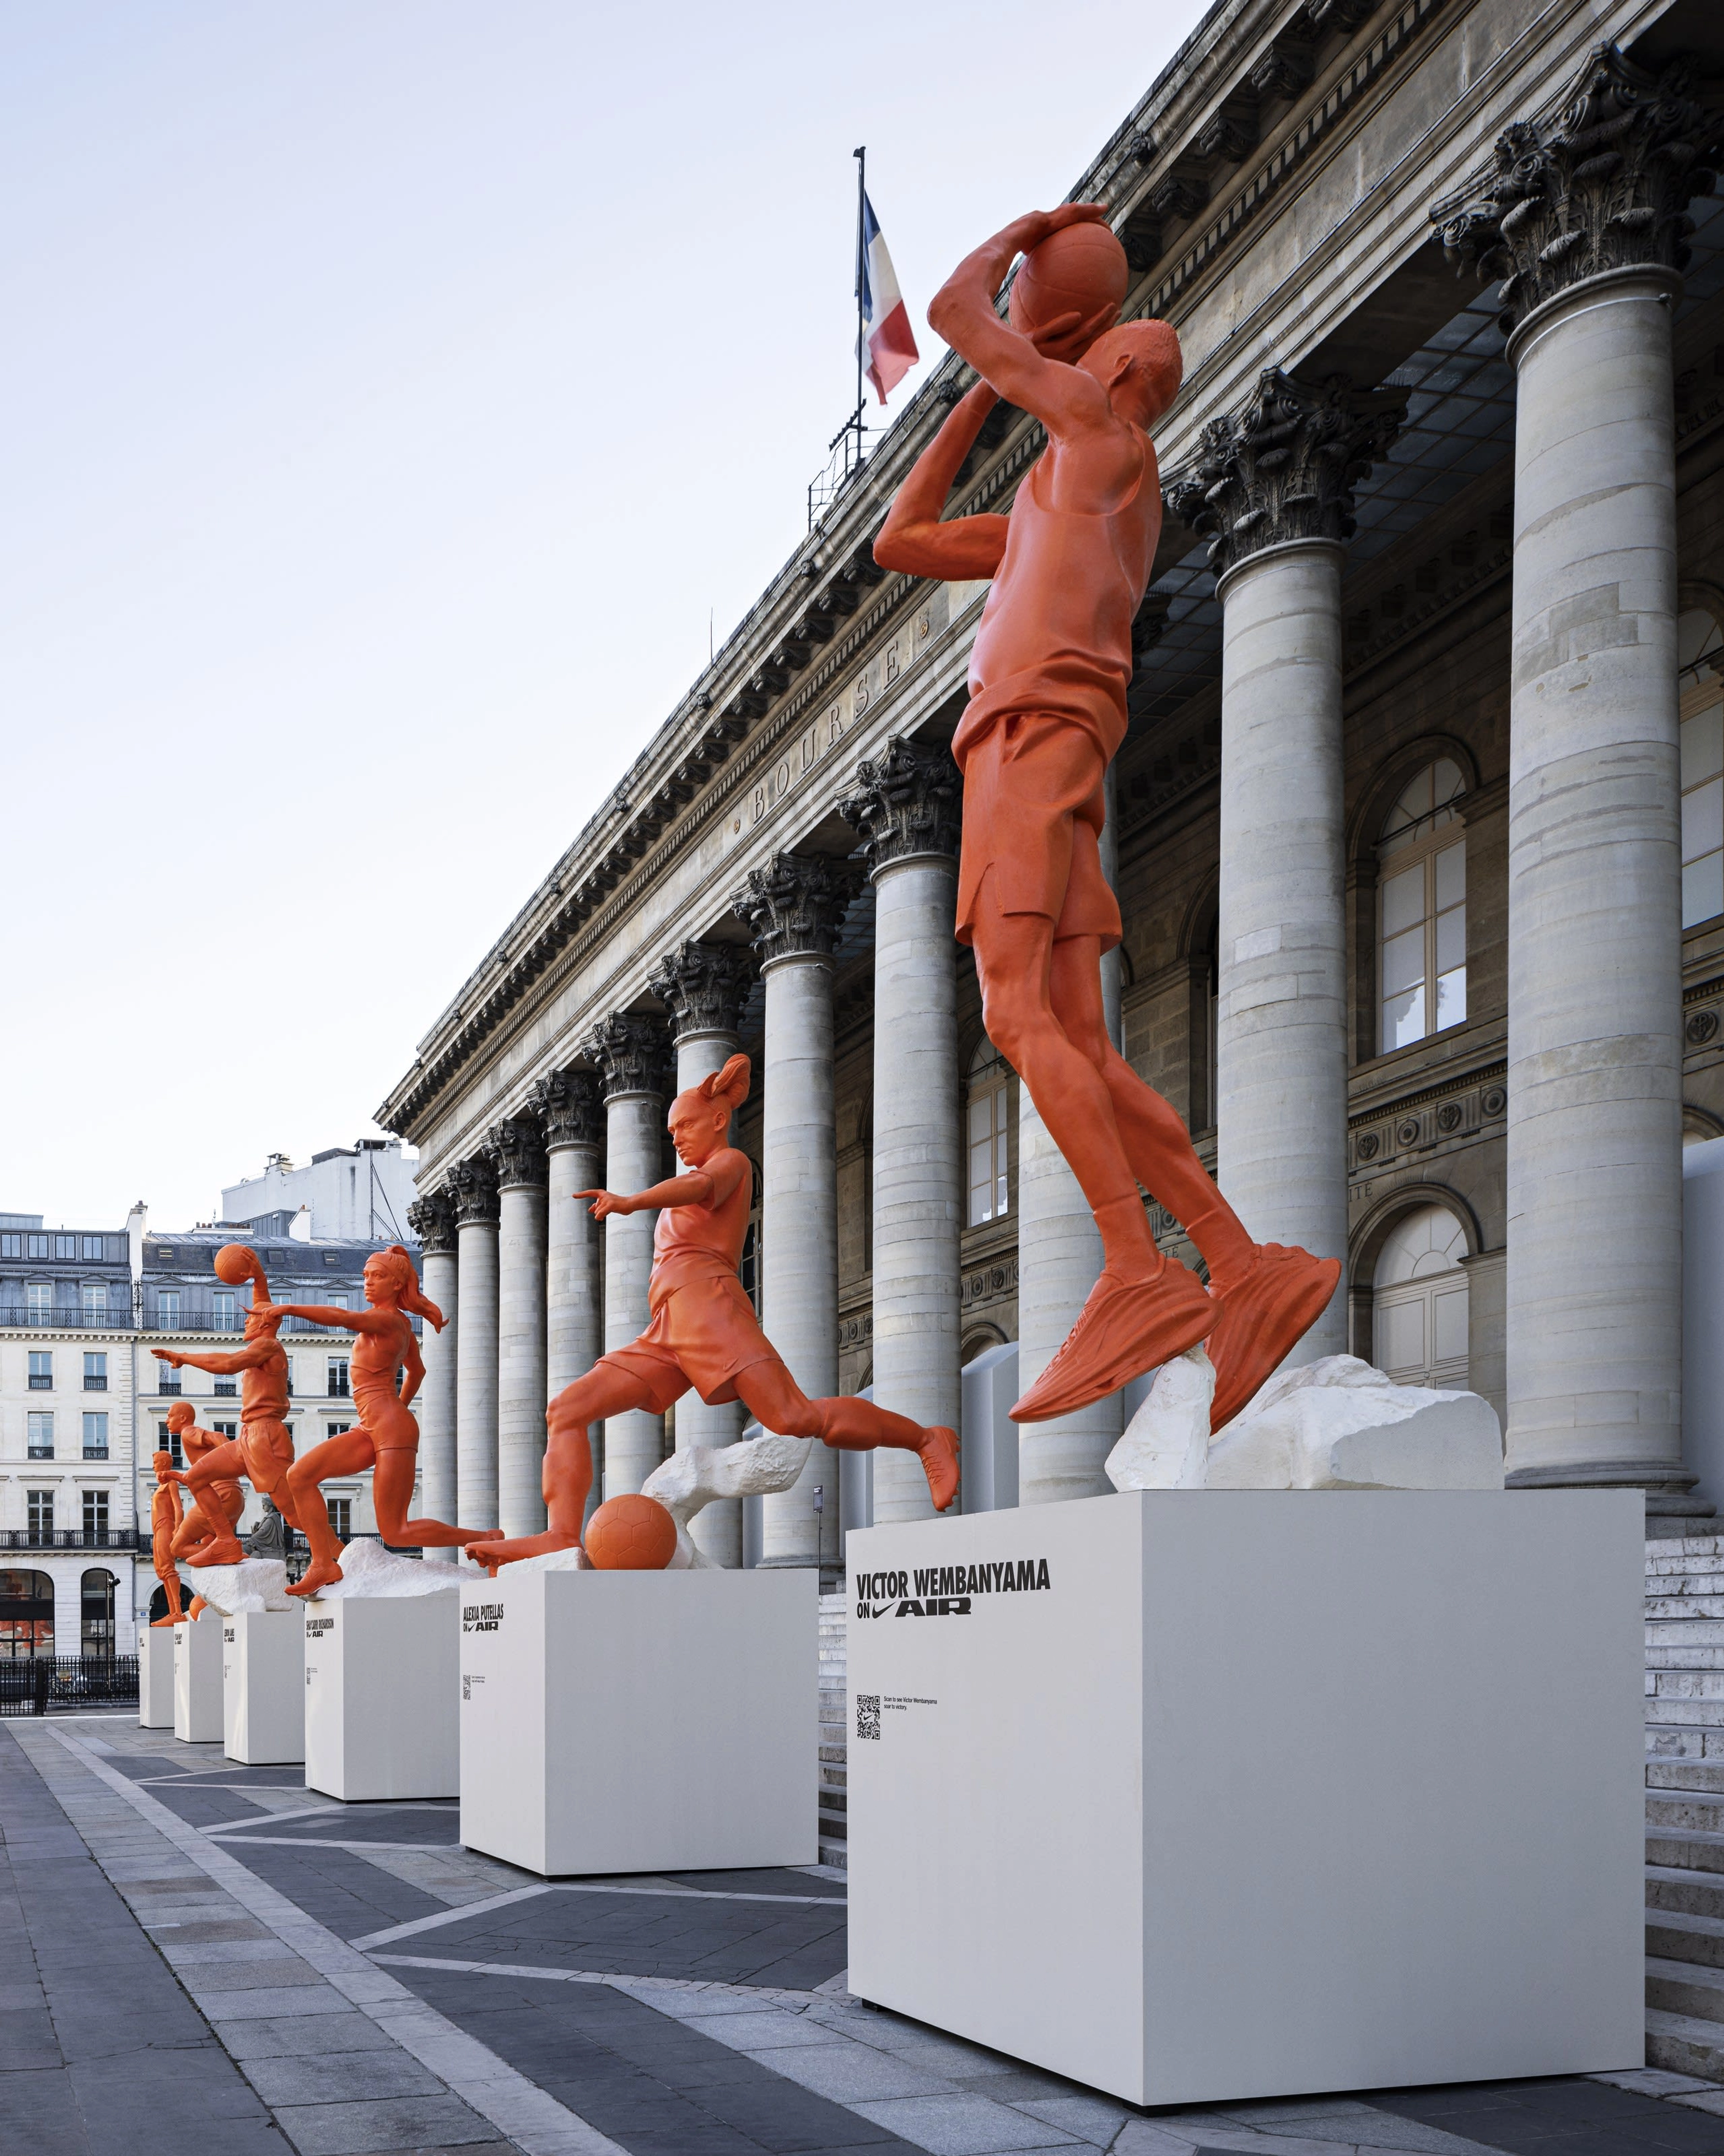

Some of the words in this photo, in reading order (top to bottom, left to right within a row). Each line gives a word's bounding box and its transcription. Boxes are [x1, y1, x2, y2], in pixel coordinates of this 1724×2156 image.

[753, 641, 899, 824] BOURSE
[857, 1571, 909, 1600] VICTOR
[913, 1558, 1051, 1597] WEMBANYAMA
[463, 1606, 479, 1622] ALEXIA
[481, 1603, 504, 1621] PUTELLAS
[857, 1602, 870, 1619] ON
[895, 1597, 972, 1618] AIR
[475, 1621, 499, 1632] AIR
